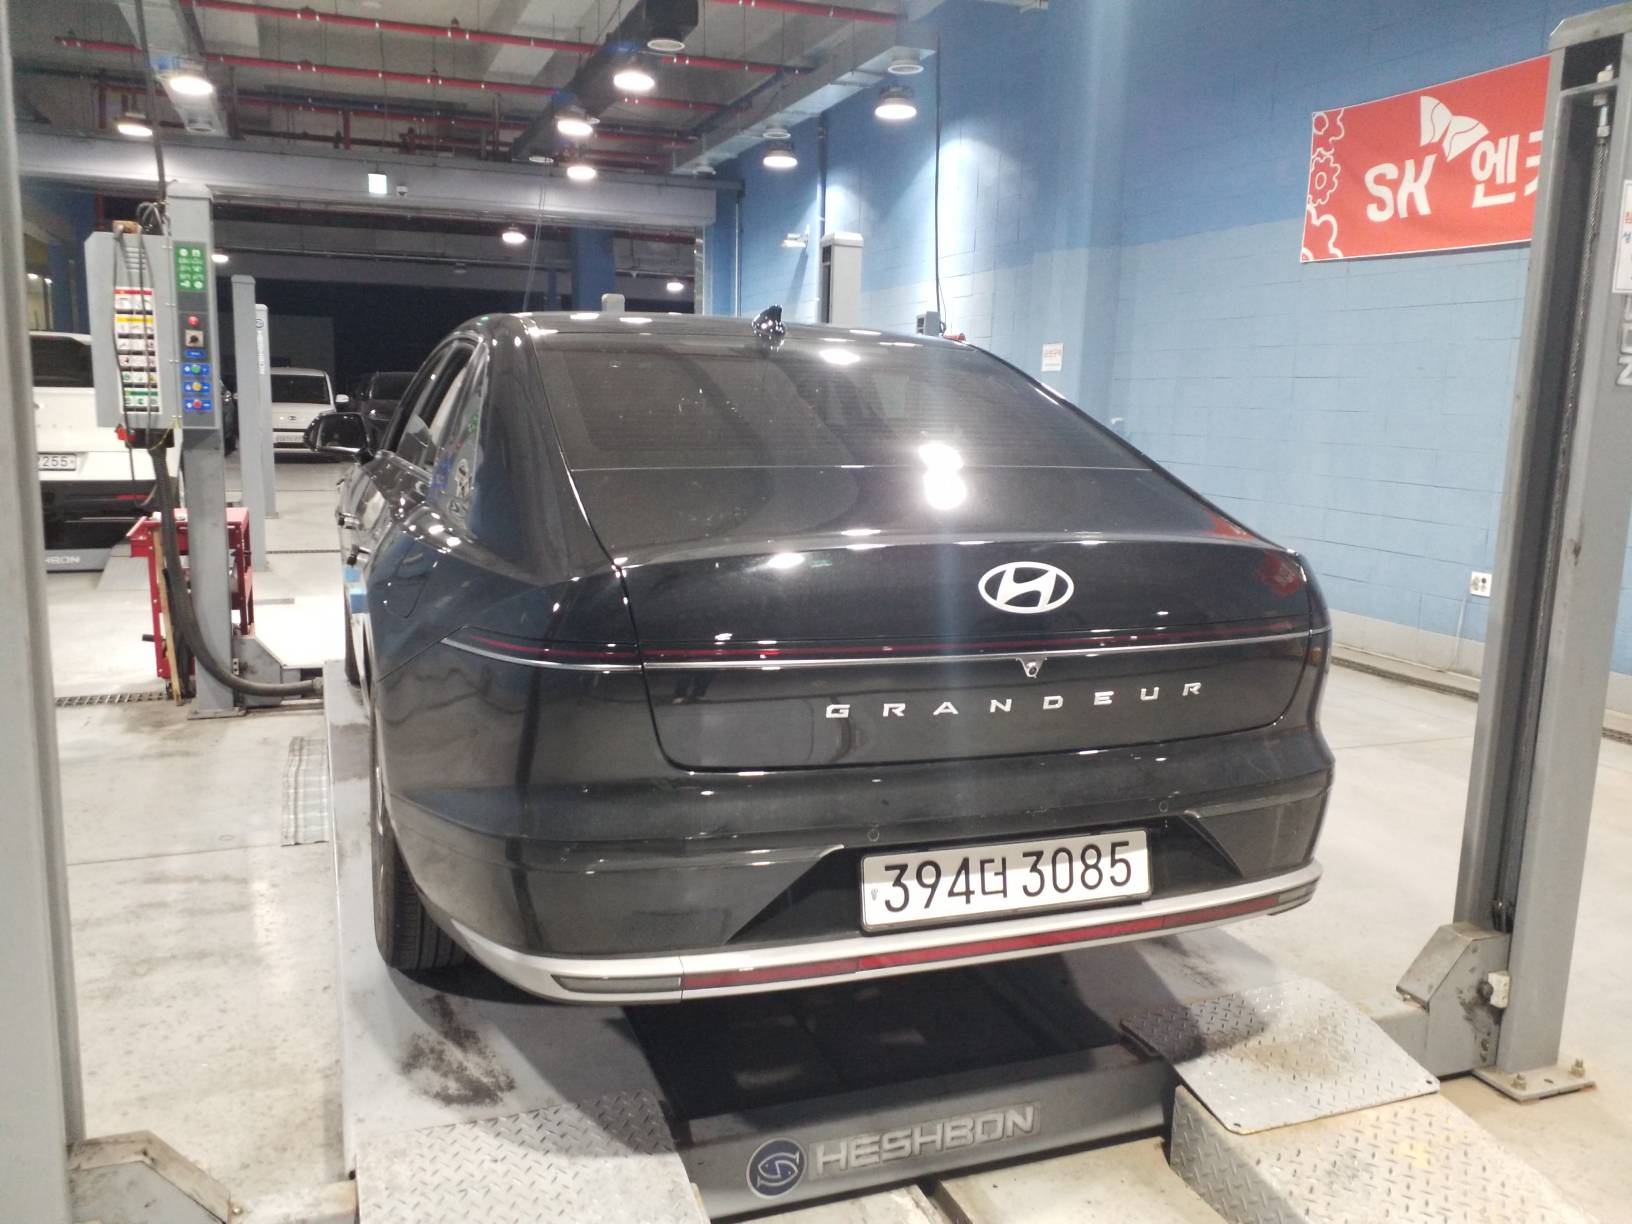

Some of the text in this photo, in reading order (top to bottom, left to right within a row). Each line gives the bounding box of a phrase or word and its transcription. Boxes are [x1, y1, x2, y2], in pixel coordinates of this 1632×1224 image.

[1364, 153, 1437, 222] SK
[38, 455, 69, 468] 255
[825, 682, 1202, 718] GRANDEUR
[884, 841, 1132, 913] 394더 3085
[815, 1105, 1035, 1174] HESHBON
